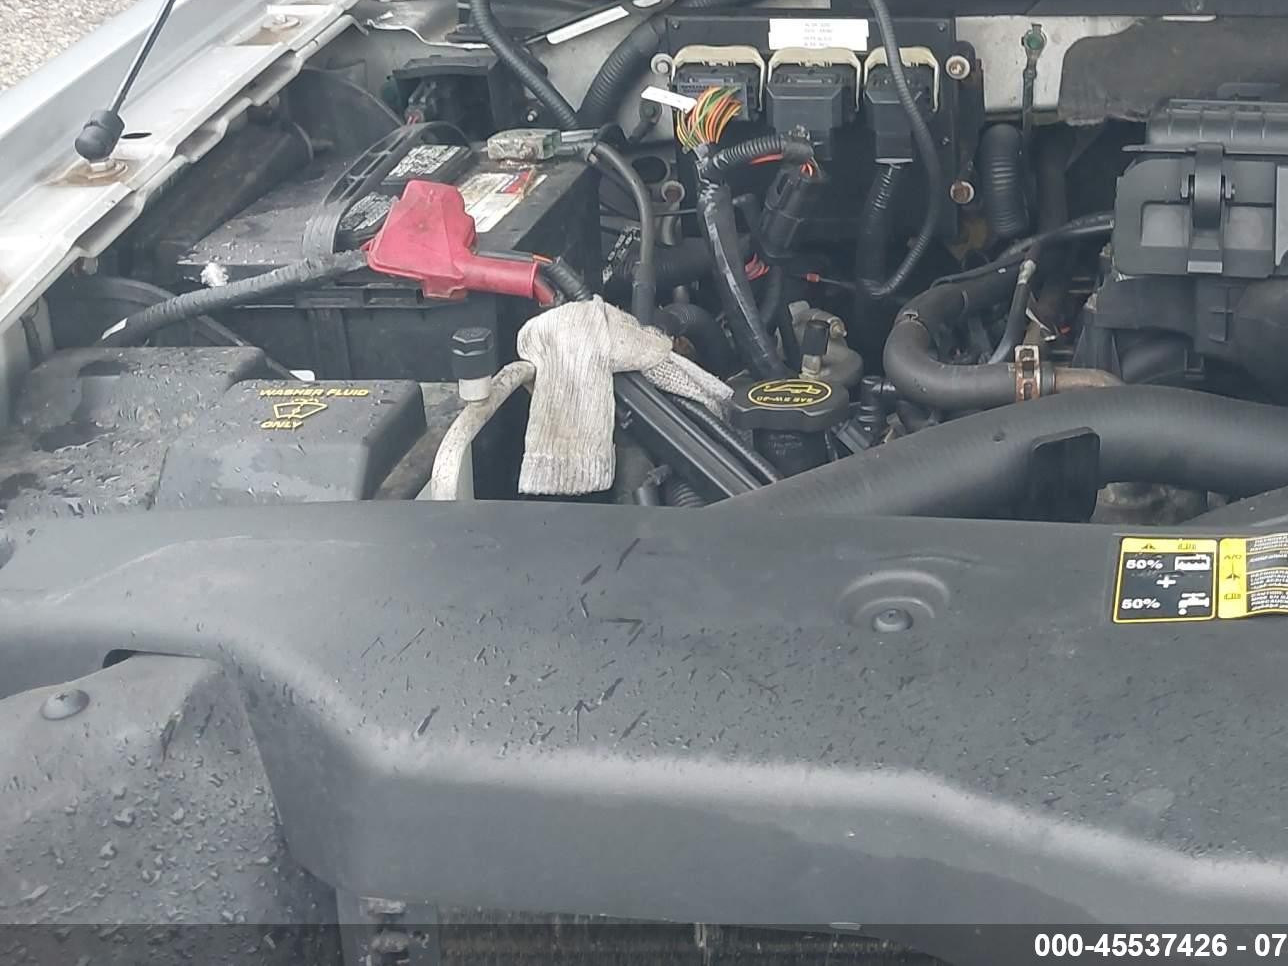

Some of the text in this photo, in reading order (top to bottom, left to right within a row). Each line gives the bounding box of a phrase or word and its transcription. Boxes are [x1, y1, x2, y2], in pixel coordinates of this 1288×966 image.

[260, 388, 369, 397] WASHER FLUID
[260, 420, 303, 429] ONLY
[1125, 559, 1164, 570] 50%
[1121, 598, 1161, 610] 50%
